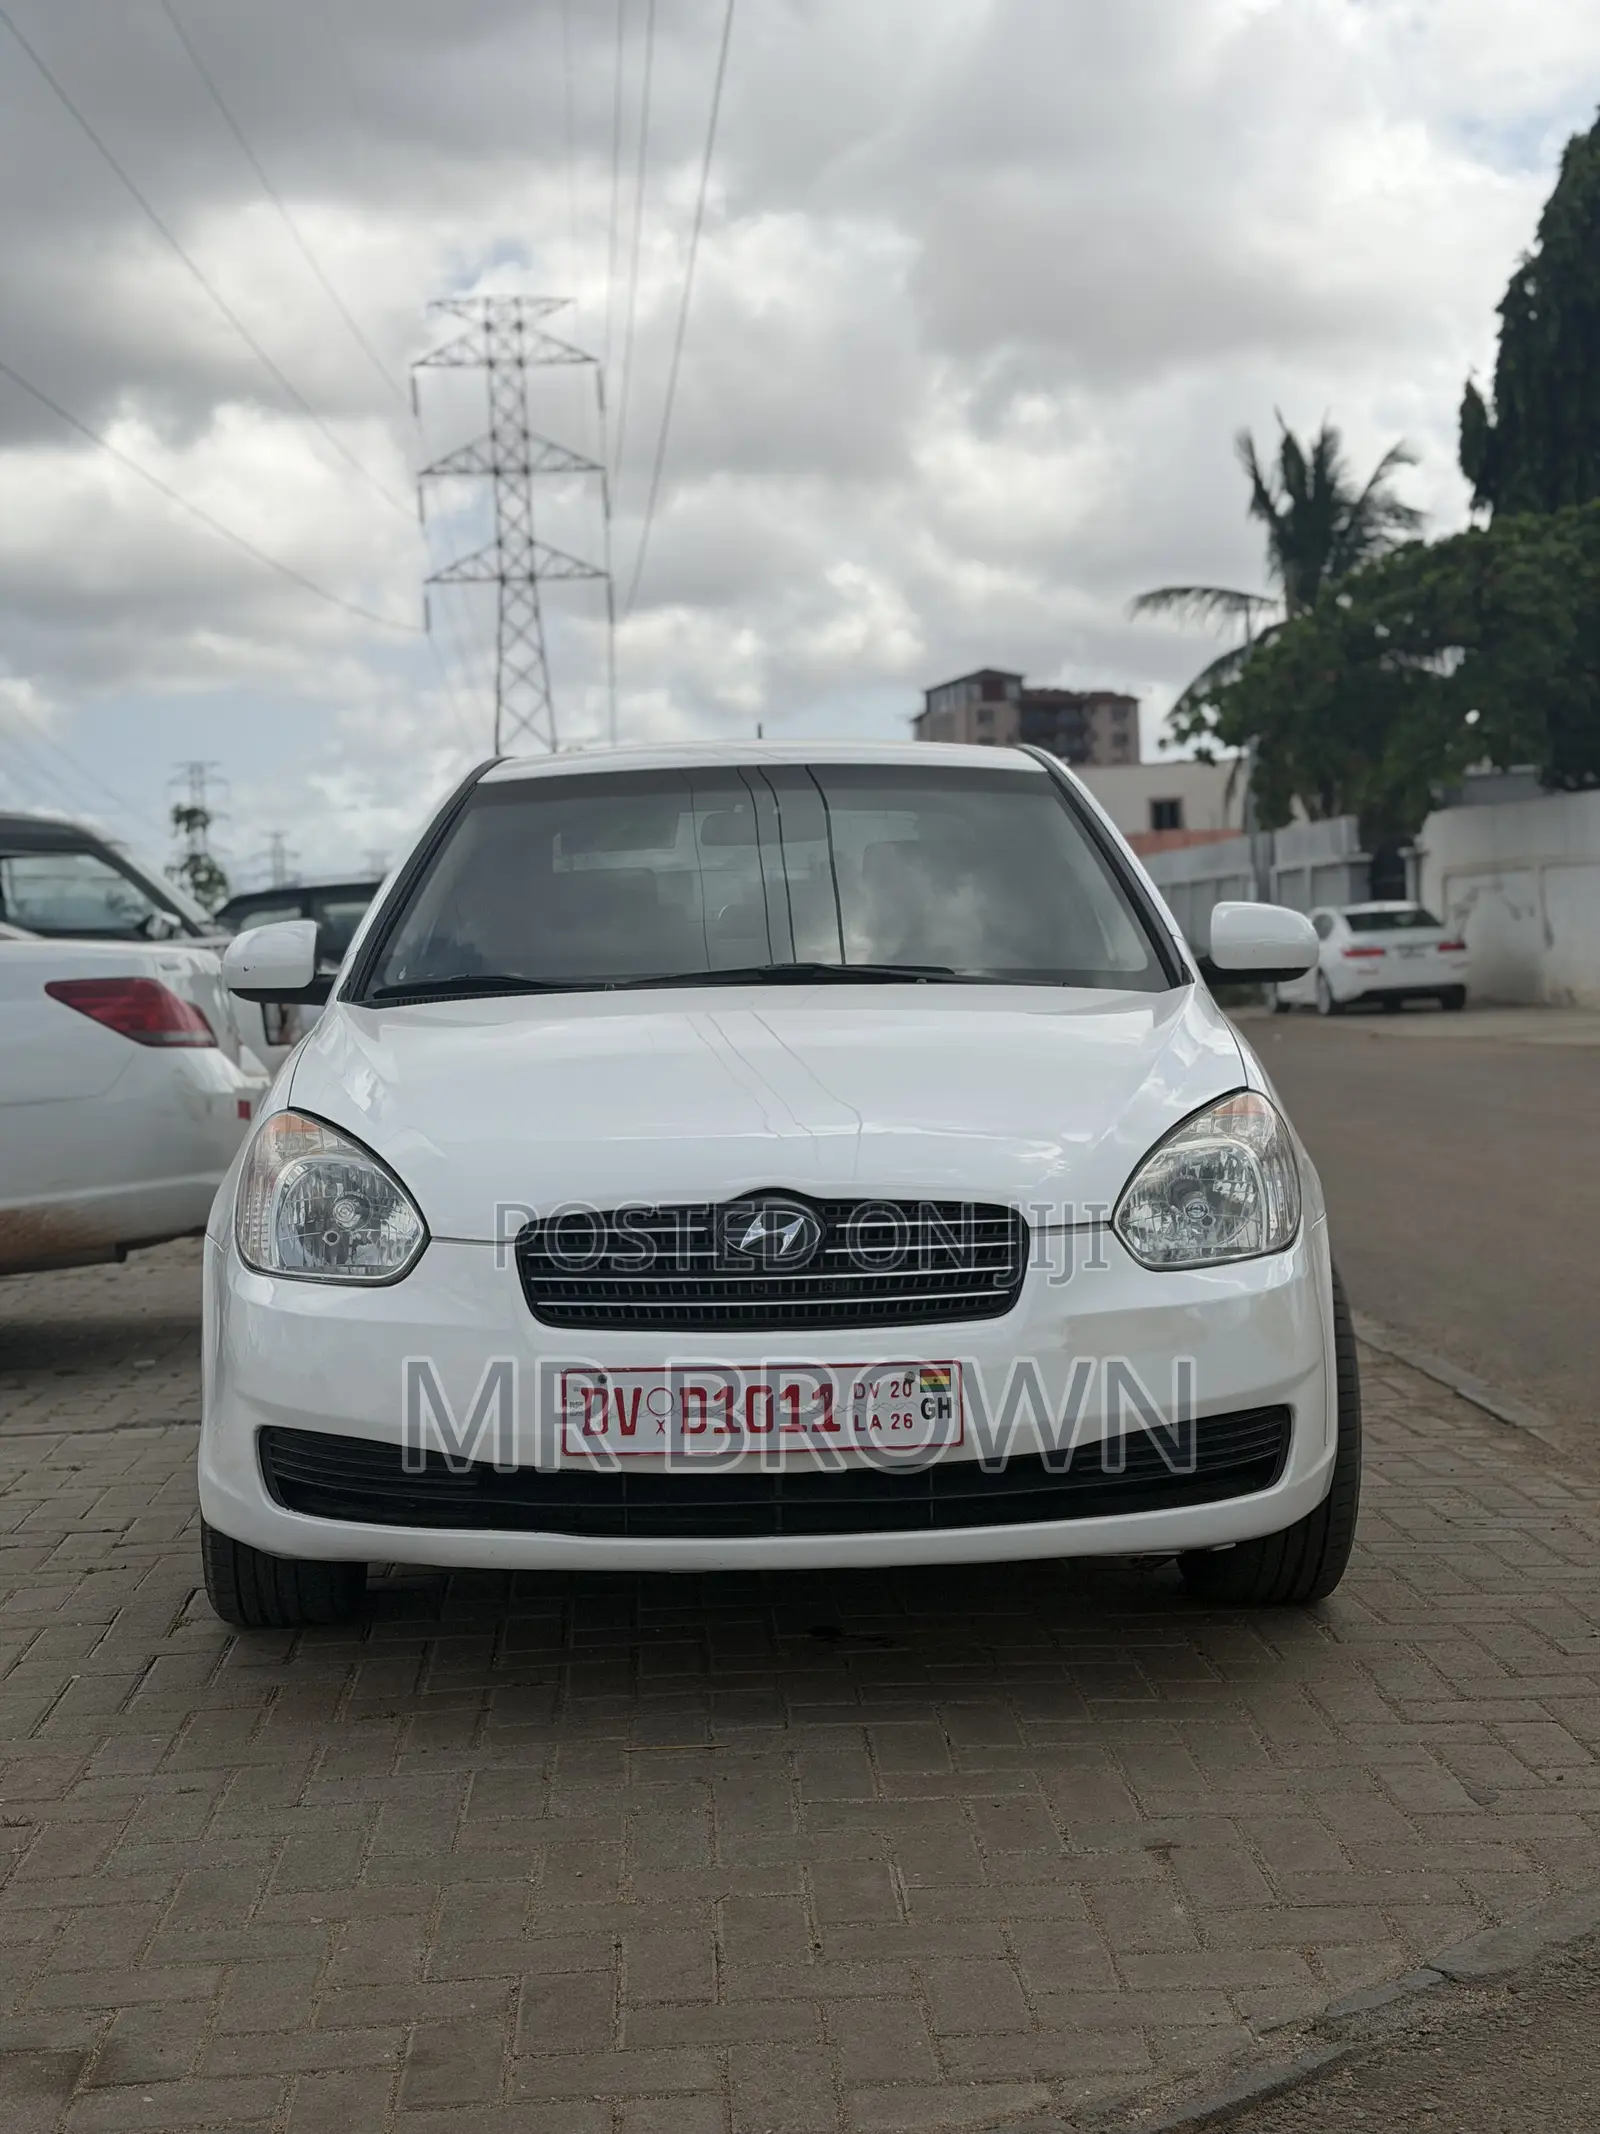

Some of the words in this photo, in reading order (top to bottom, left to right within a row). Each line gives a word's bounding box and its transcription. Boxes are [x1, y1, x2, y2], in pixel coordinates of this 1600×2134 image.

[853, 1382, 880, 1399] DV
[890, 1380, 913, 1398] 20
[580, 1386, 642, 1436] DV
[679, 1383, 841, 1434] D1011
[920, 1396, 952, 1420] GH
[854, 1413, 882, 1431] LA
[891, 1412, 913, 1430] 26
